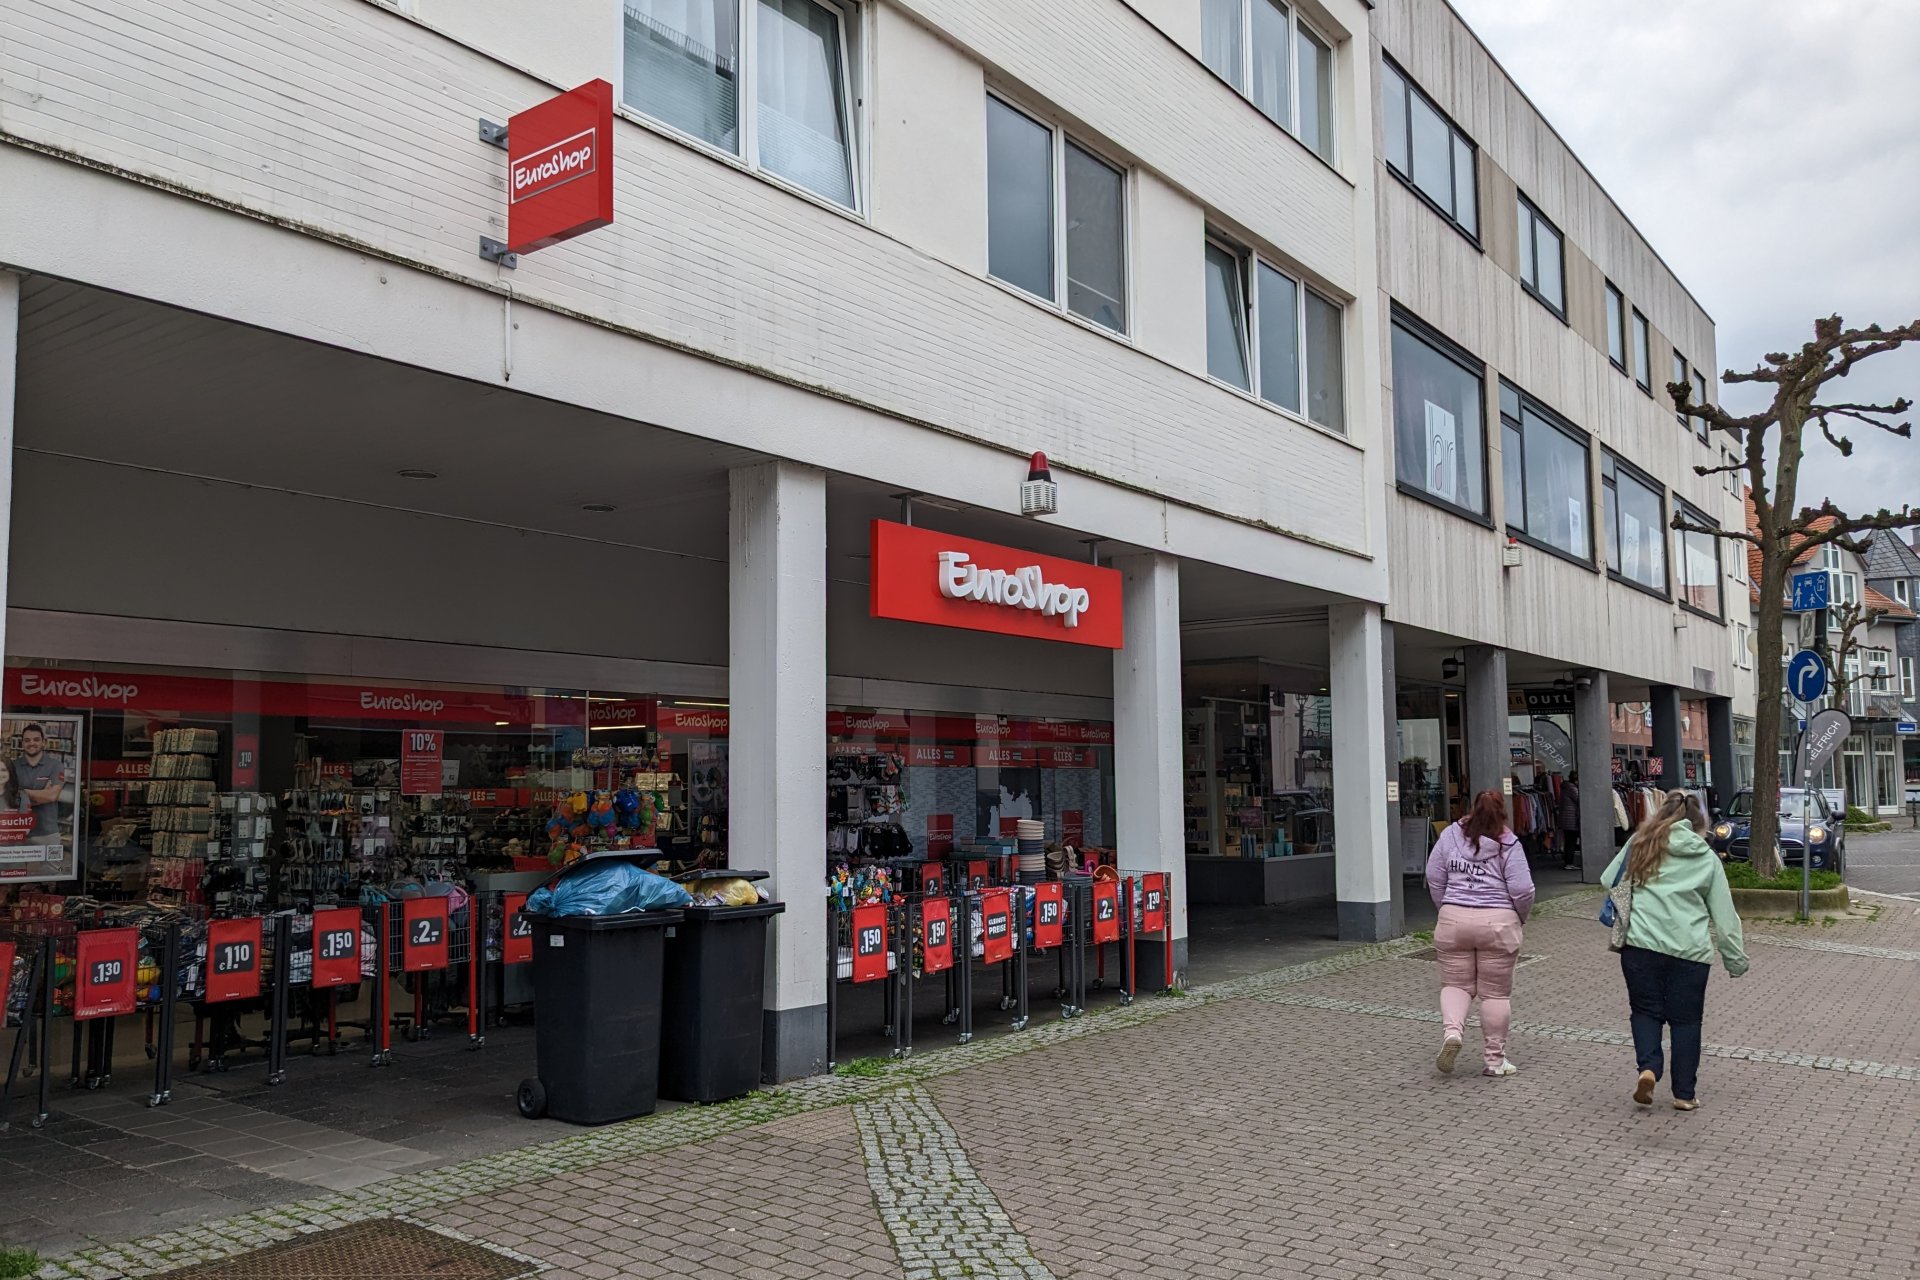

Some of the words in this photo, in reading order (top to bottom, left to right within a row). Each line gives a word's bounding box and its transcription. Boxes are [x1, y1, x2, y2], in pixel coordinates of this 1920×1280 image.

[515, 146, 591, 189] EuroShop
[938, 551, 1089, 627] EuroShop
[21, 674, 138, 702] EuroShop
[360, 692, 444, 716] EuroShop
[1508, 696, 1524, 705] IR
[1528, 694, 1572, 704] OUTL
[675, 713, 728, 731] EuroShop
[845, 716, 890, 733] EuroShop
[975, 723, 1011, 737] EuroShop
[411, 733, 436, 751] 10%
[1810, 721, 1841, 764] ELFRICH
[916, 748, 941, 760] ALLES
[989, 750, 1010, 760] ALLES
[116, 763, 150, 774] ALLES
[324, 765, 345, 775] LLES
[1, 817, 33, 826] sucht?
[1450, 860, 1486, 876] HUND
[988, 924, 1007, 935] PREISE
